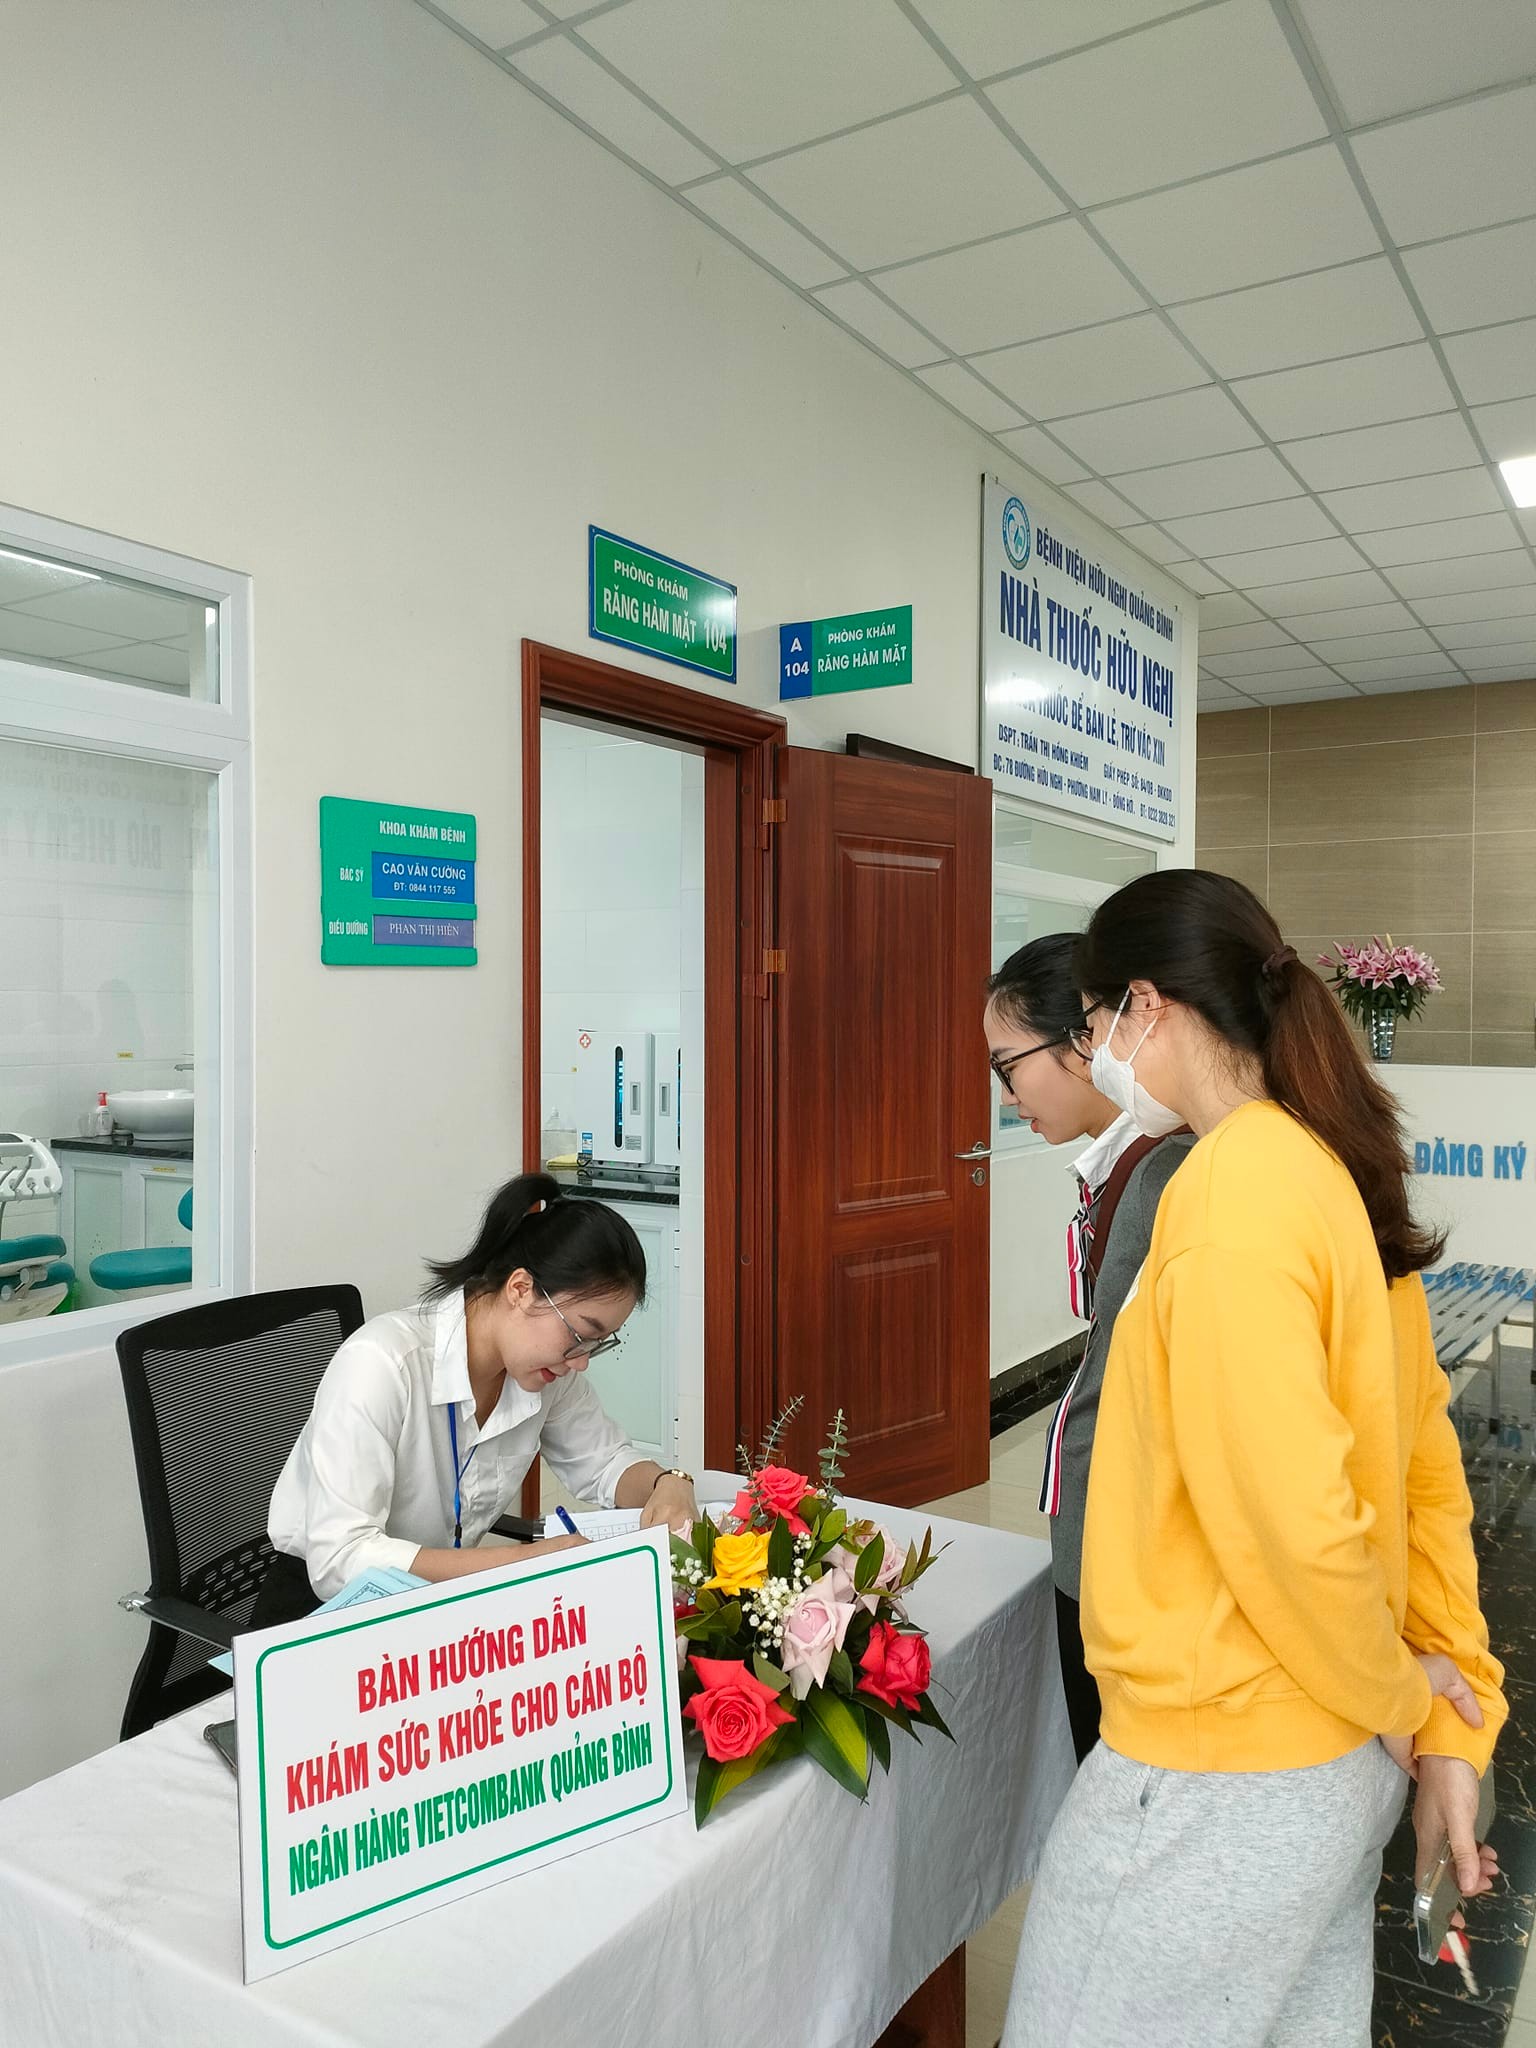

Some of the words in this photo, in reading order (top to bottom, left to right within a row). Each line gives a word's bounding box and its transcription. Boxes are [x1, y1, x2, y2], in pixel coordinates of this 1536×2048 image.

[614, 558, 654, 588] PHÒNG
[657, 579, 688, 601] KHÁM
[1037, 528, 1063, 571] BỆNH
[1066, 549, 1086, 586] VIỆN
[1089, 563, 1106, 598] HỮU
[1108, 577, 1128, 617] NGHỊ
[1129, 591, 1155, 631] QUẢNG
[1157, 607, 1174, 642] BÌNH
[603, 583, 640, 625] RĂNG
[642, 599, 670, 635] HÀM
[672, 613, 697, 649] MẶT
[703, 620, 727, 656] 104
[828, 625, 864, 645] PHÒNG
[866, 622, 896, 638] KHÁM
[790, 637, 803, 653] A
[817, 648, 850, 673] RĂNG
[852, 647, 880, 668] HÀM
[882, 645, 908, 665] MẶT
[1000, 570, 1042, 652] NHÀ
[1046, 597, 1102, 682] THUỐC
[1107, 628, 1138, 700] HỮU
[1142, 655, 1174, 728] NGHỊ
[784, 661, 810, 677] 104
[1086, 704, 1105, 741] BÁN
[1153, 737, 1165, 767] XIN
[379, 820, 407, 837] KHOA
[409, 823, 438, 840] KHÁM
[440, 826, 466, 845] BỆNH
[339, 865, 354, 882] BÁC
[382, 862, 405, 876] CAO
[407, 862, 428, 877] VĂN
[431, 865, 466, 881] CƯỜNG
[393, 881, 408, 892] ĐT:
[409, 883, 427, 893] 0844
[429, 884, 441, 893] 117
[443, 885, 456, 895] 555
[389, 922, 417, 935] PHAN
[419, 924, 435, 937] THỊ
[1415, 1136, 1483, 1177] ĐĂNG
[1493, 1141, 1527, 1180] KÝ
[357, 1653, 420, 1714] BÀN
[429, 1626, 524, 1689] HƯỚNG
[533, 1596, 587, 1658] DẪN
[286, 1740, 370, 1814] KHÁM
[378, 1718, 430, 1783] SỨC
[438, 1689, 504, 1763] KHỎE
[511, 1681, 559, 1738] CHO
[566, 1660, 612, 1720] CÁN
[618, 1645, 648, 1707] BỘ
[289, 1824, 349, 1896] NGÂN
[355, 1808, 409, 1872] HÀNG
[414, 1759, 547, 1847] VIETCOMBANK
[550, 1731, 609, 1803] QUẢNG
[612, 1720, 653, 1775] BÌNH
